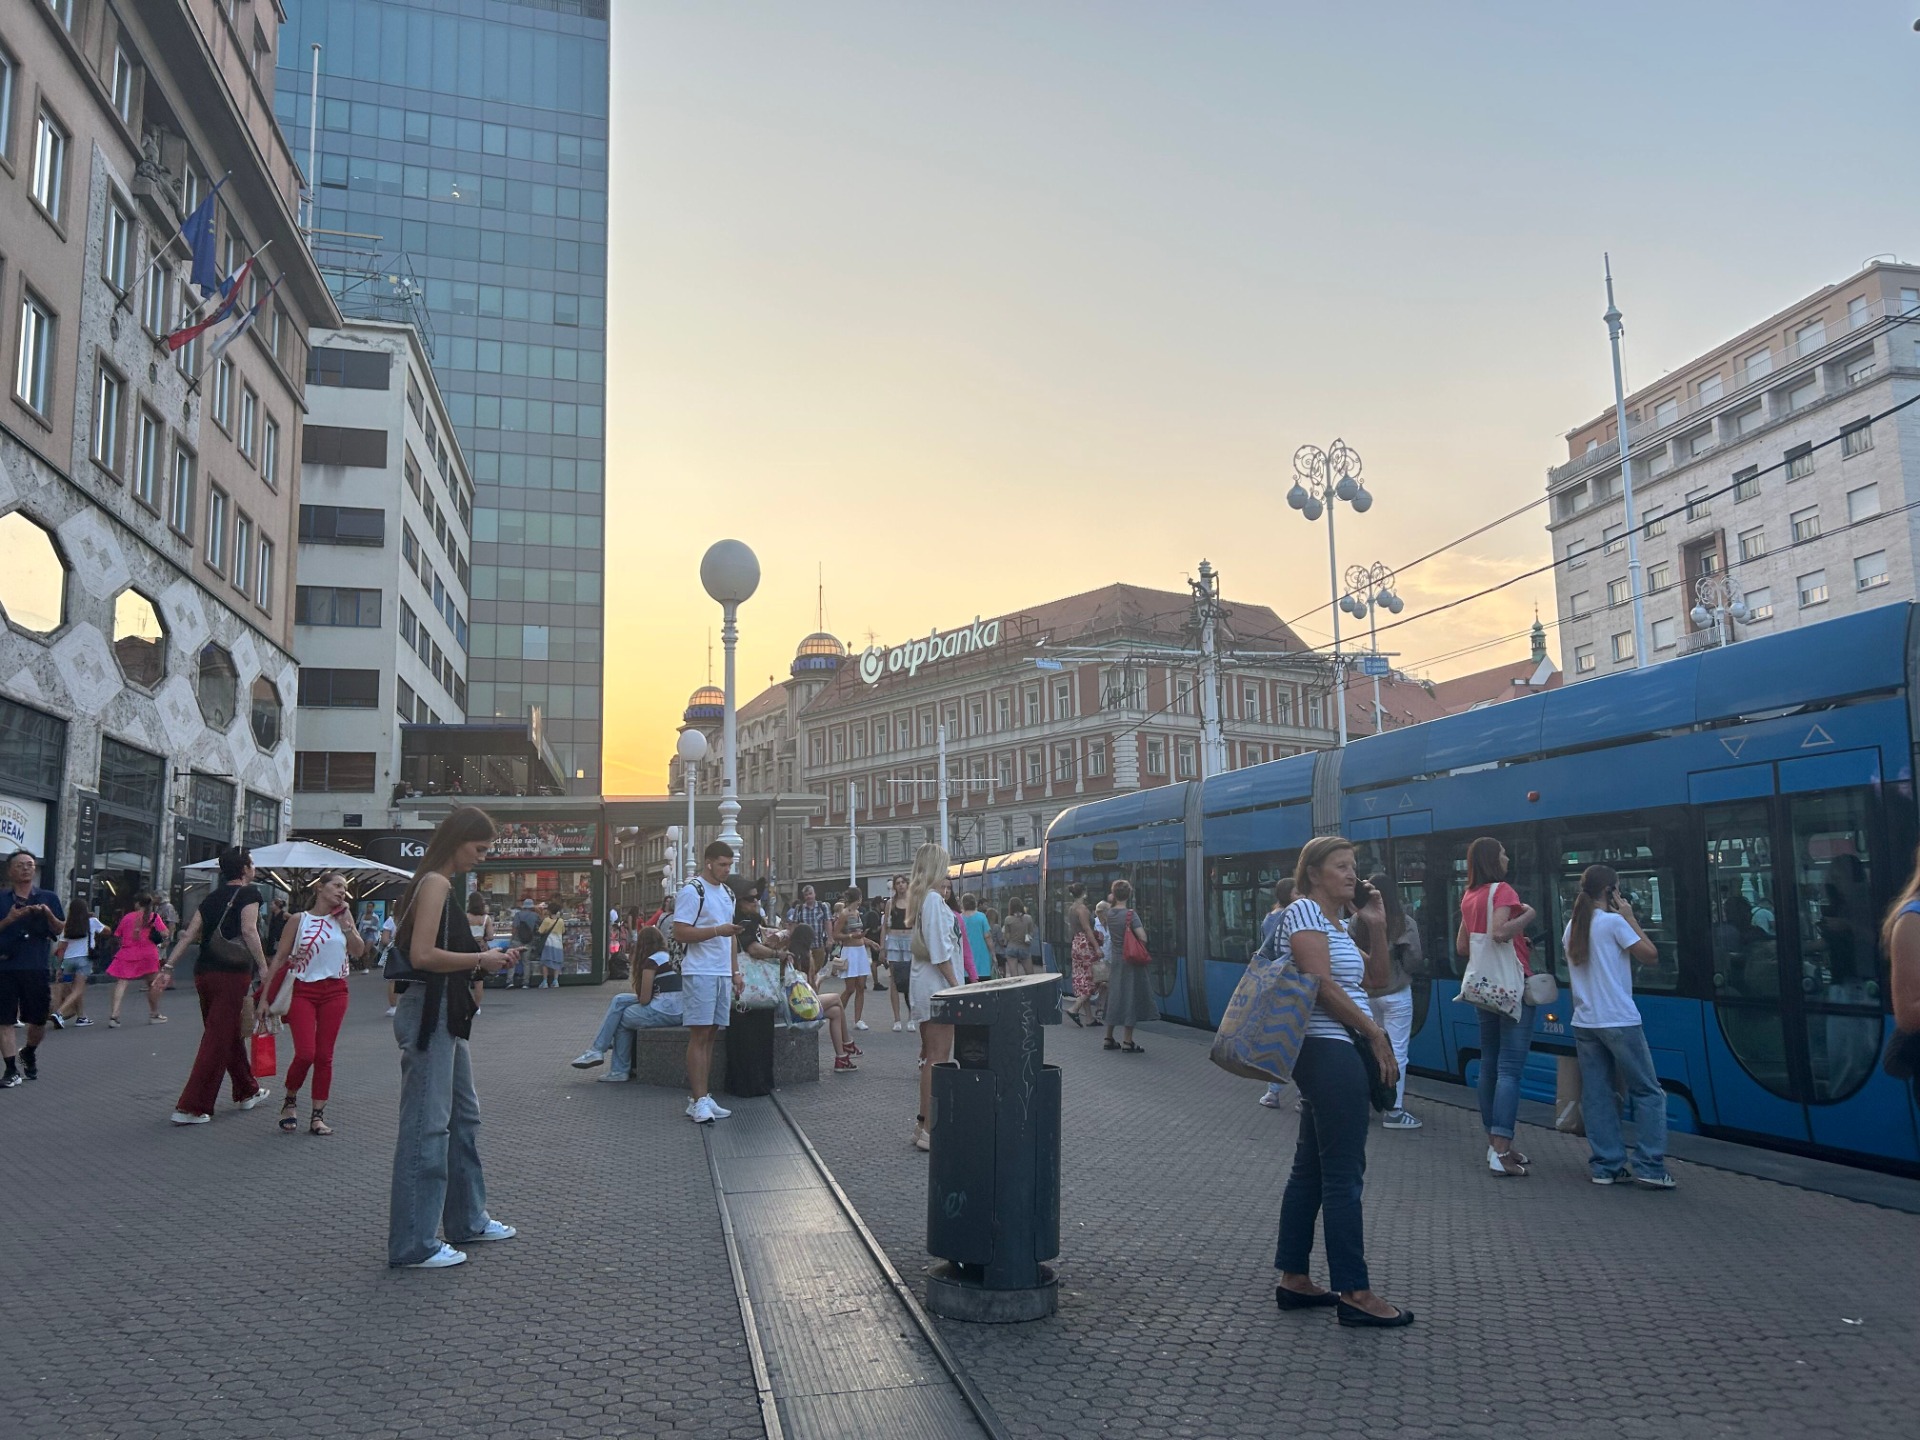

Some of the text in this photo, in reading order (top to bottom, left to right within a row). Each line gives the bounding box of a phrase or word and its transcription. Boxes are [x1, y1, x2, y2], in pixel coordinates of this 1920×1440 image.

[12, 809, 28, 828] BEST
[400, 842, 430, 857] Ka
[1543, 1022, 1564, 1034] 2280
